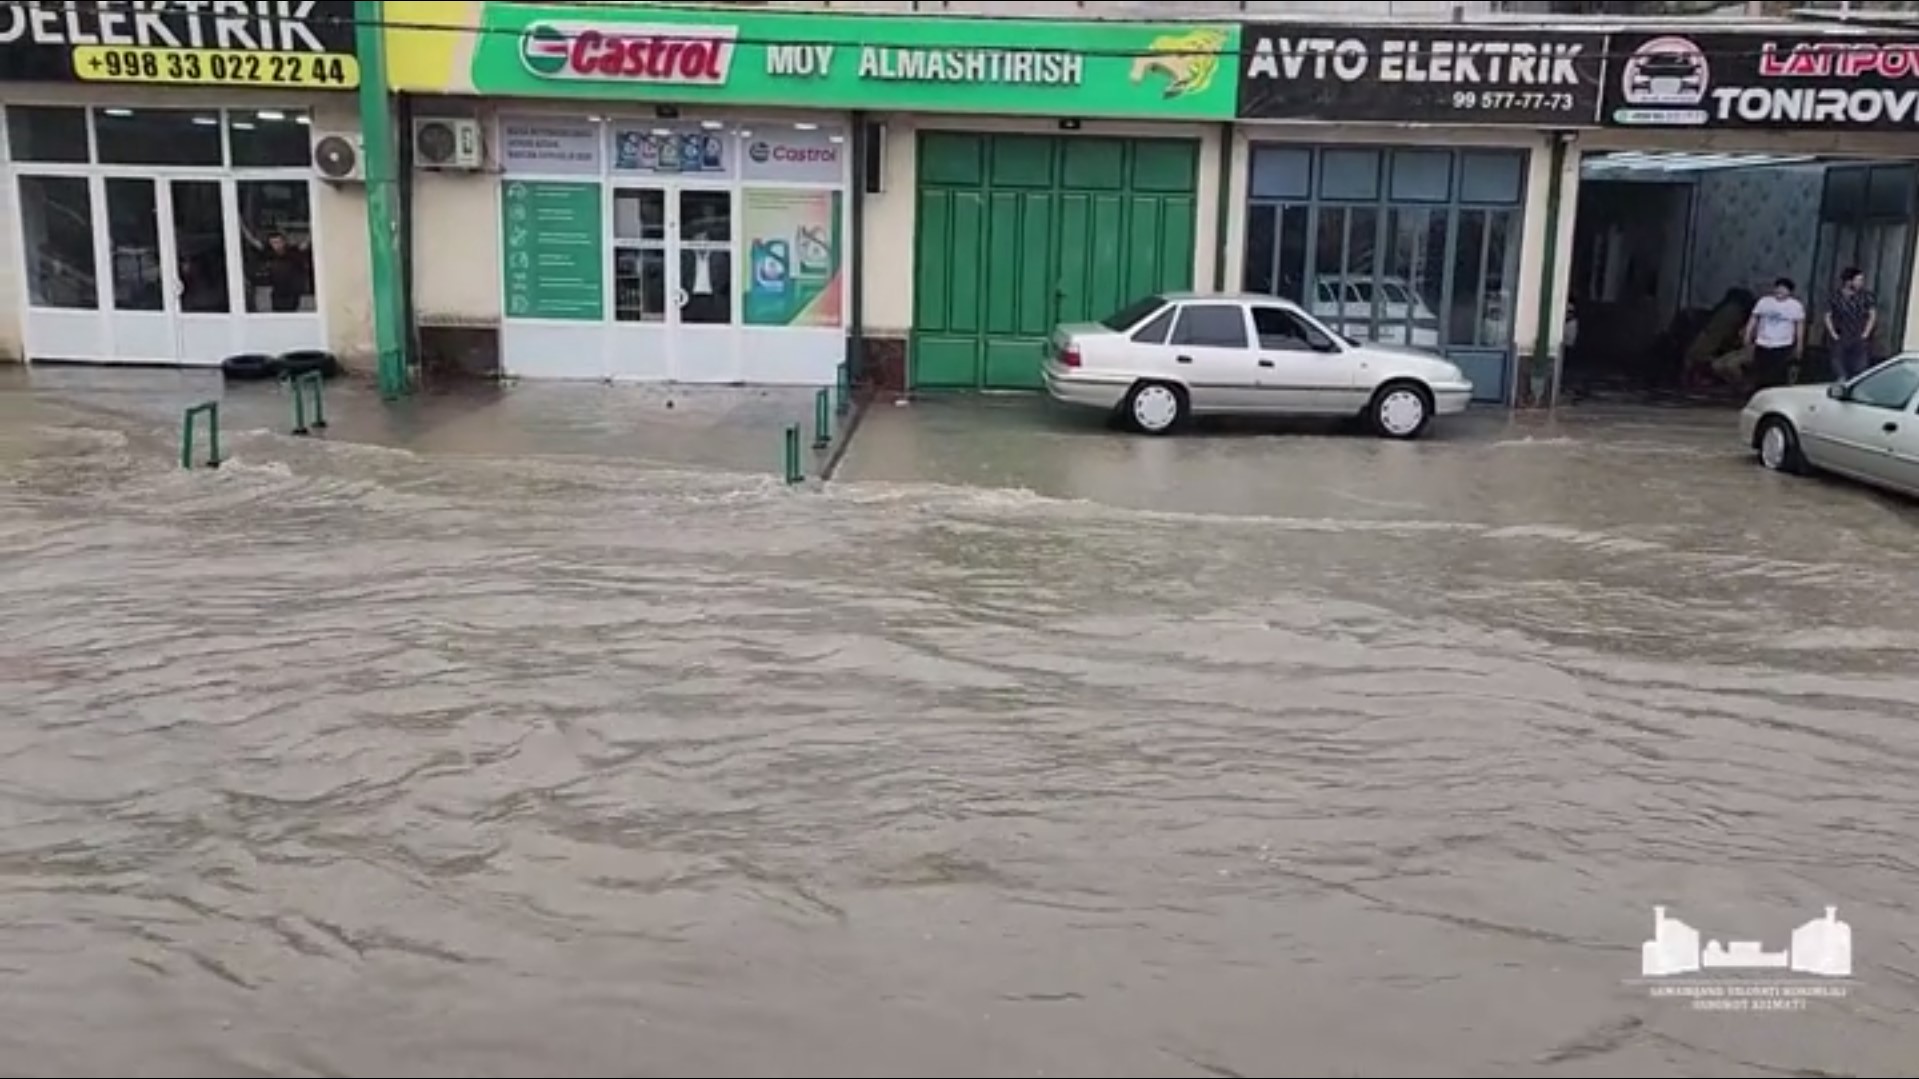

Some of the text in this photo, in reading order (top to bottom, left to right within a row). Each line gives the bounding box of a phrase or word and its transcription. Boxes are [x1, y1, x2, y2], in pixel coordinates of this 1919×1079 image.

[88, 51, 344, 84] +998 33 022 22 44
[570, 30, 722, 80] Castrol
[766, 44, 1083, 85] MOY ALMASHTIRISH
[1248, 38, 1583, 85] AVTO ELEKTRIK
[1453, 91, 1574, 111] 99 577-77-73
[1711, 86, 1919, 123] TONIROV
[773, 145, 837, 162] Castrol
